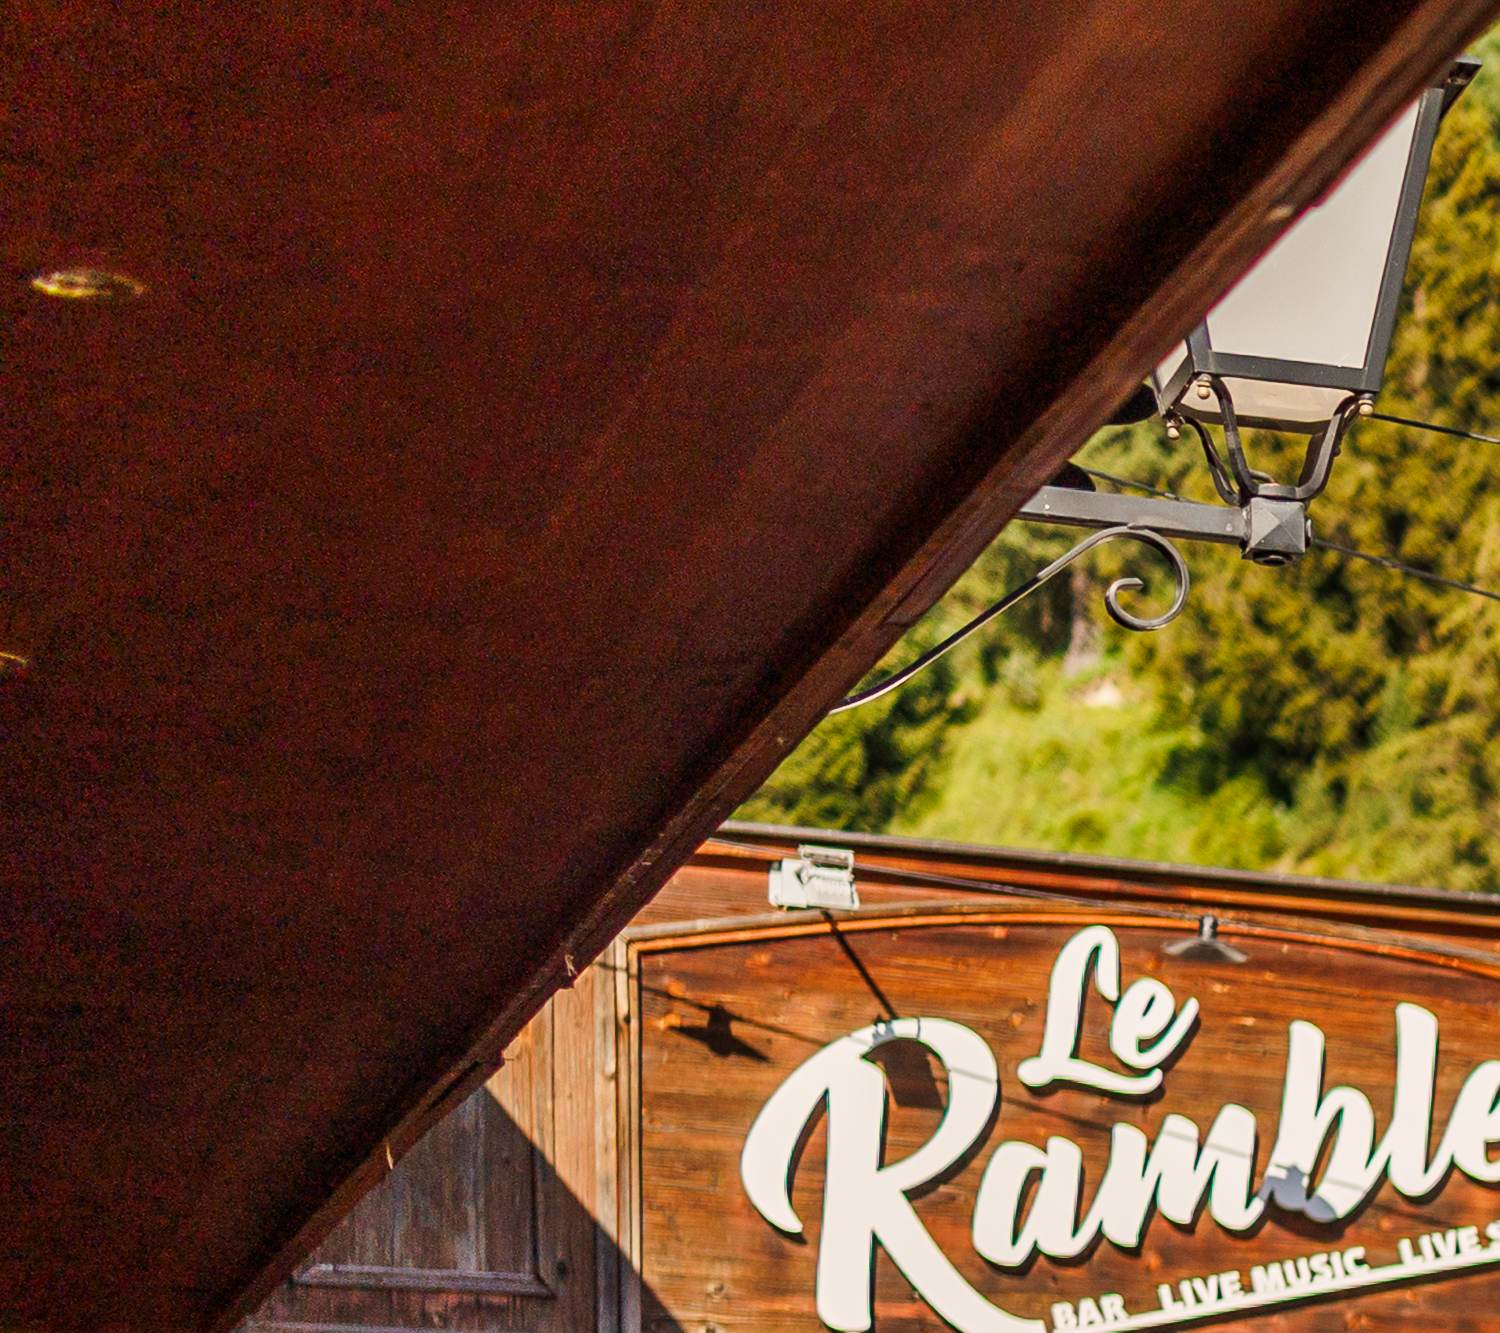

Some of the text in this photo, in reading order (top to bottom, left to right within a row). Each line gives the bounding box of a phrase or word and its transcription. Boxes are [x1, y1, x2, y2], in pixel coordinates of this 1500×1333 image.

[1017, 926, 1199, 1095] Le
[1051, 1293, 1131, 1332] BAR
[1158, 1271, 1243, 1311] LIVE
[1251, 1247, 1371, 1297] MUSIC
[1399, 1223, 1481, 1267] LIVE
